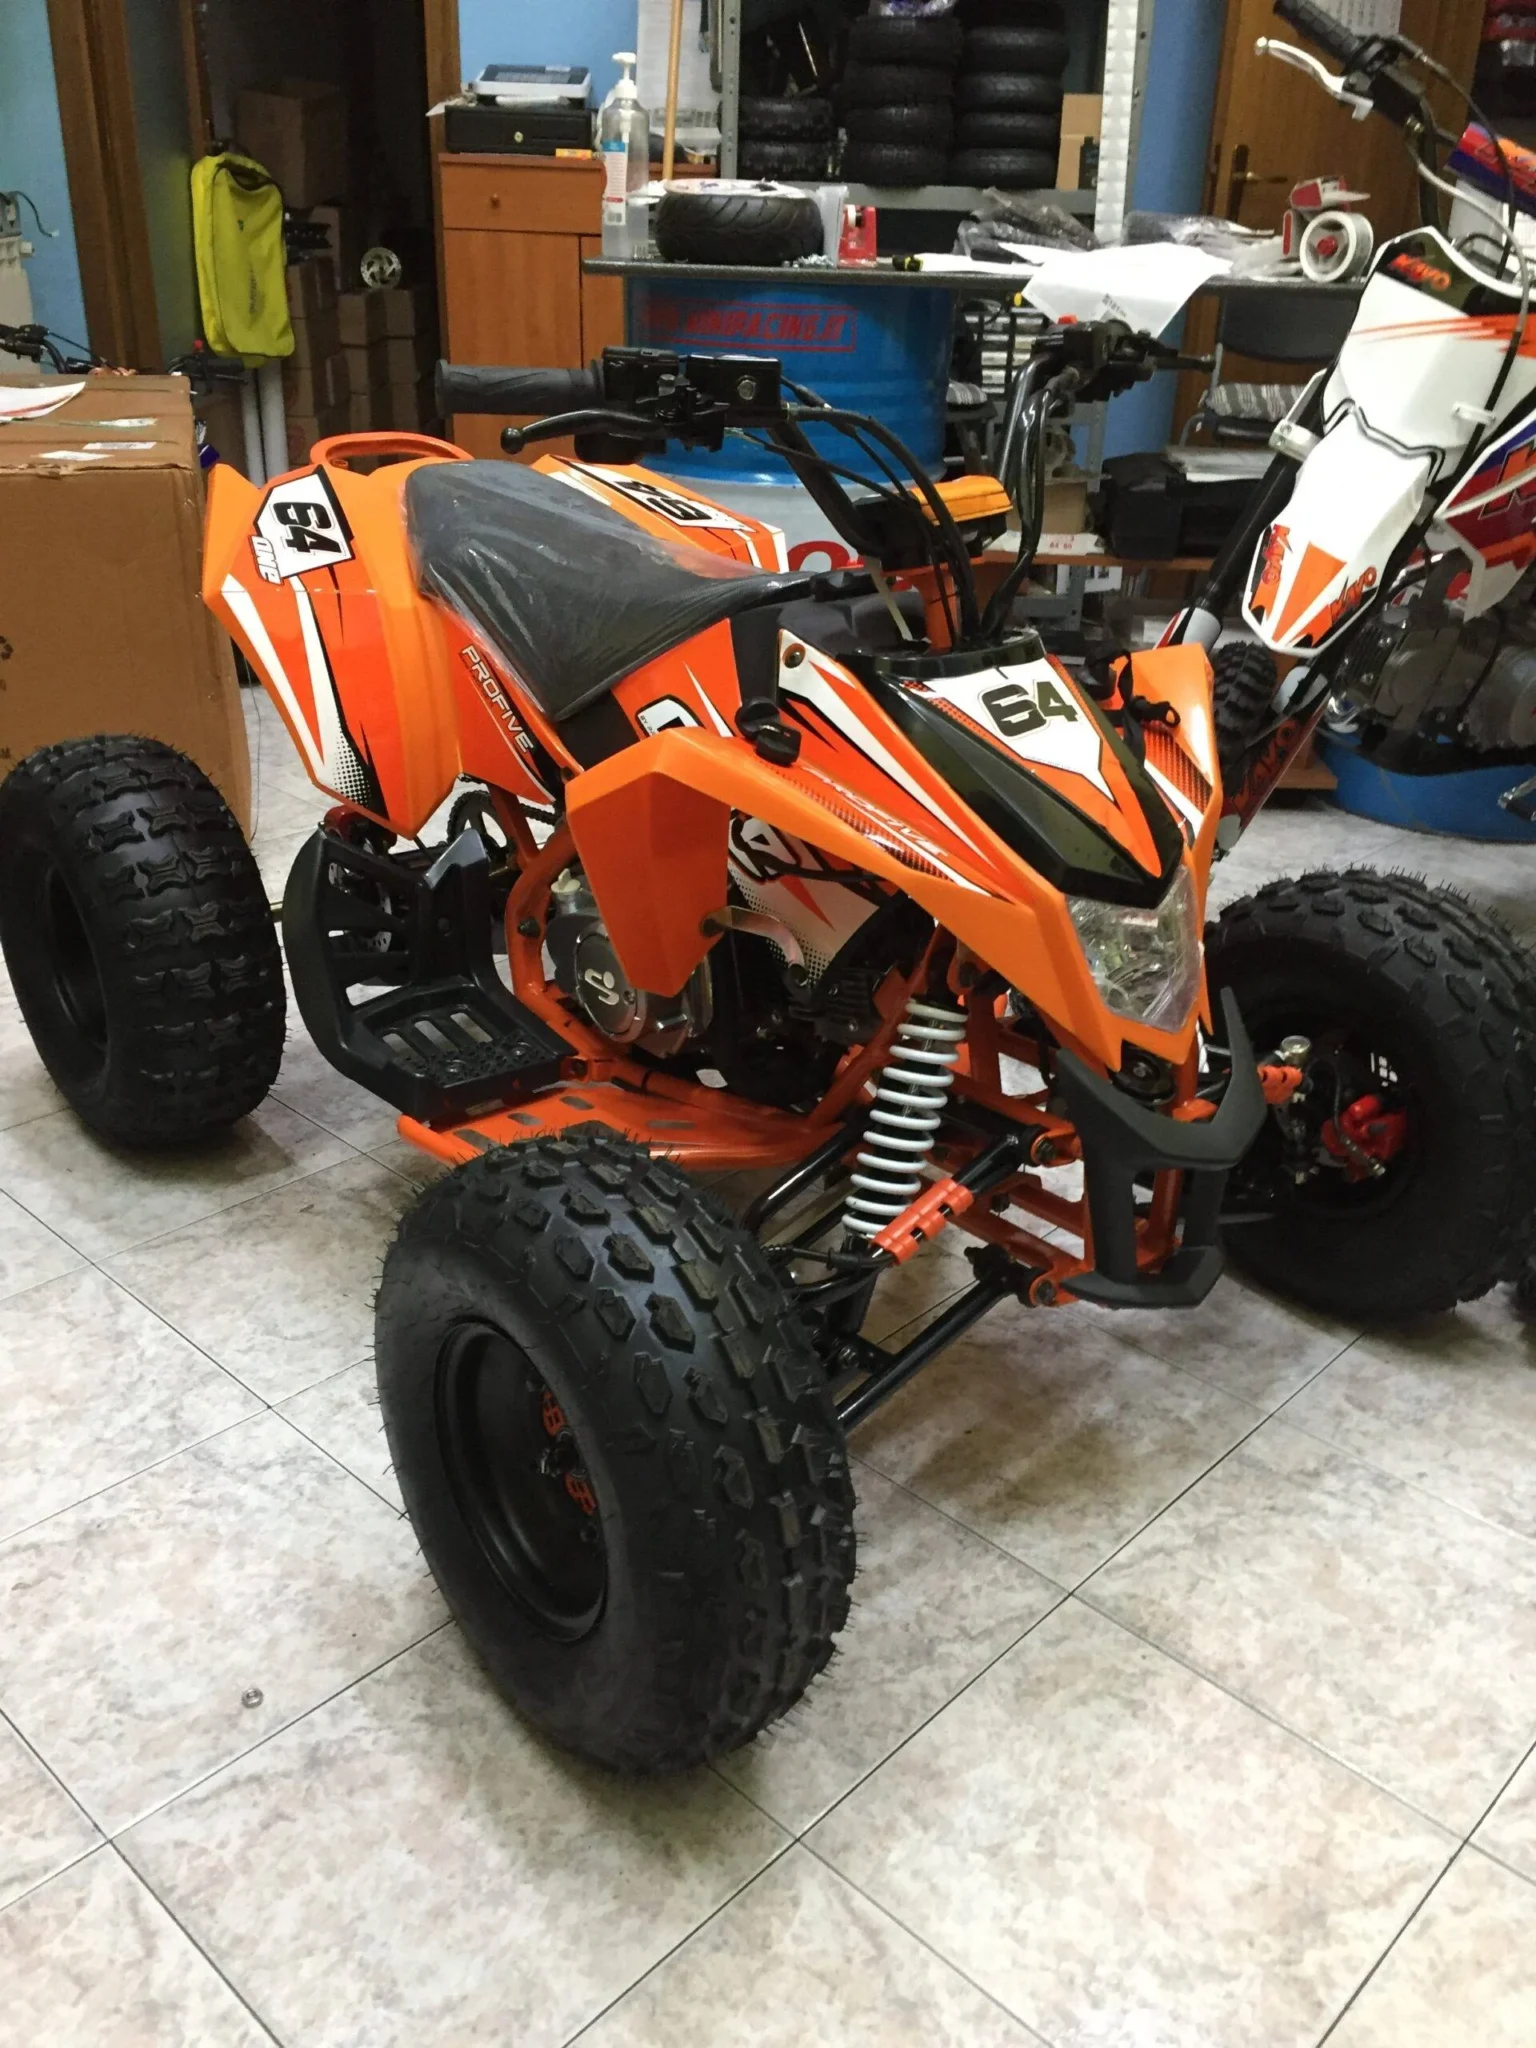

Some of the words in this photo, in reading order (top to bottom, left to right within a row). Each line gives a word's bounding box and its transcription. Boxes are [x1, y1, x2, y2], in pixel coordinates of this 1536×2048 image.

[272, 501, 342, 554] 64
[461, 643, 535, 754] PROFIVE
[980, 680, 1079, 738] 64
